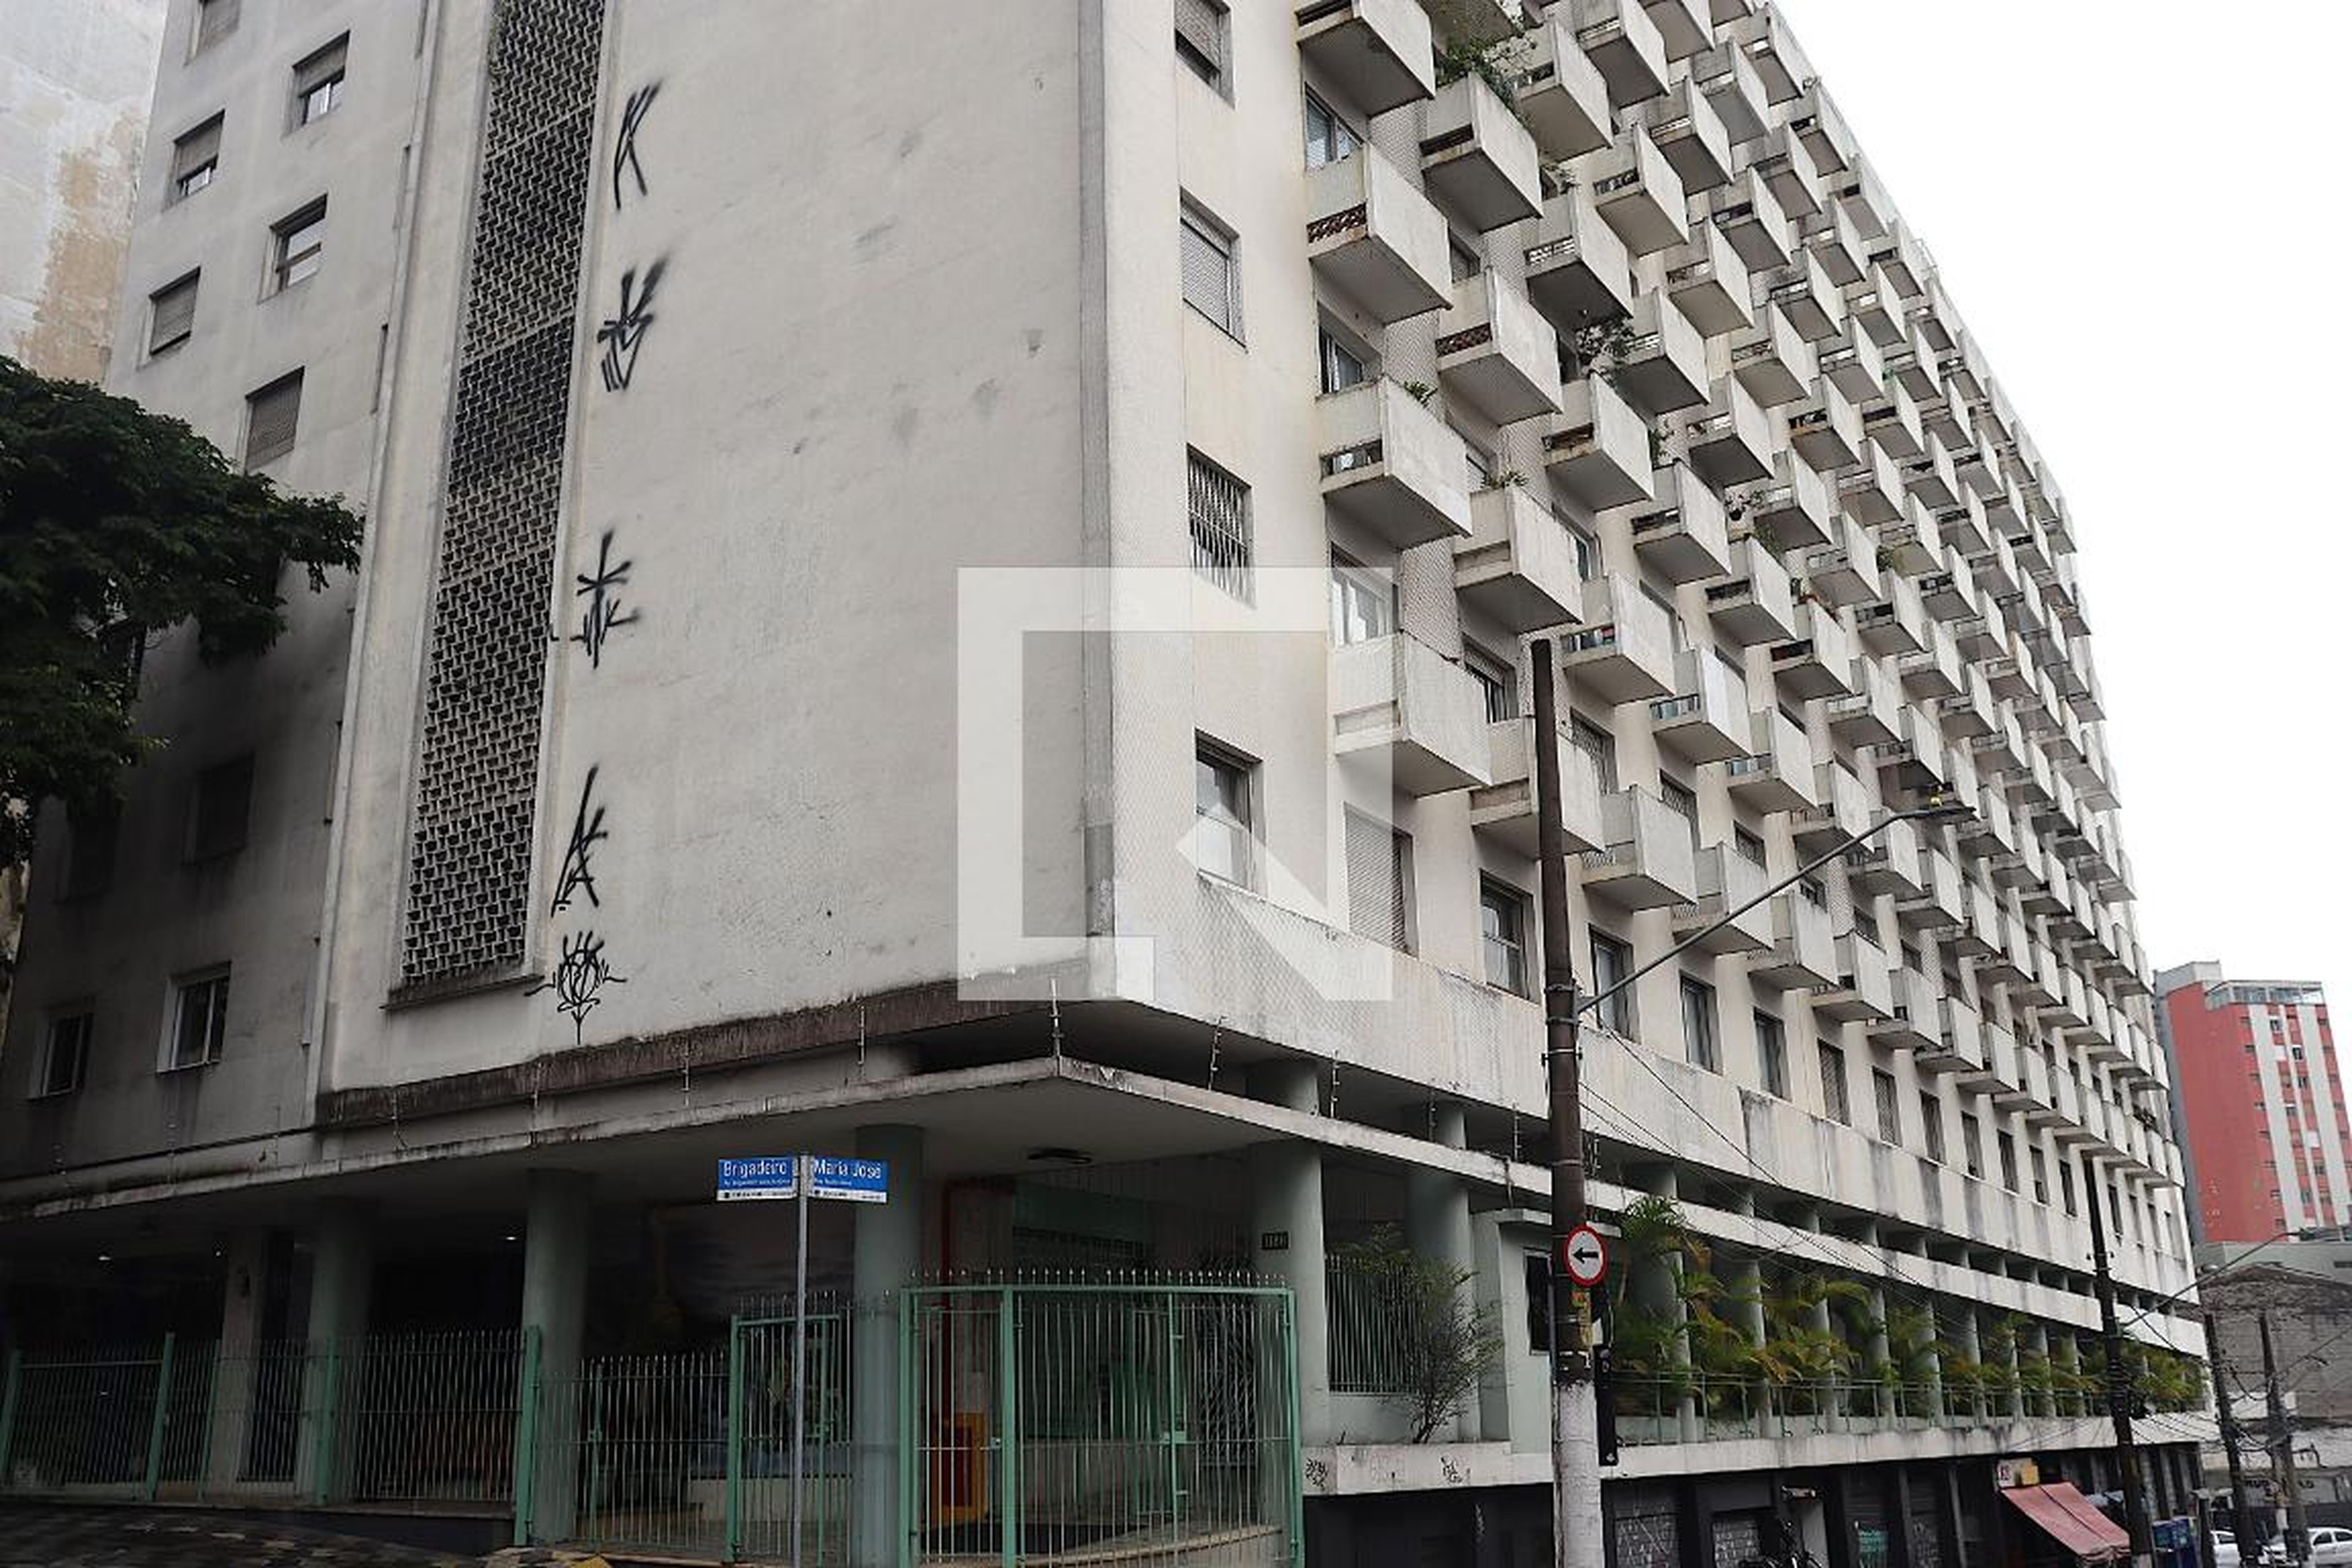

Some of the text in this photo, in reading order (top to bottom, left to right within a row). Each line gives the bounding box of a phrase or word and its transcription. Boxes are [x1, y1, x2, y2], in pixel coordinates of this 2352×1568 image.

[723, 1159, 787, 1178] Brigadeiro
[813, 1159, 881, 1179] Maria José
